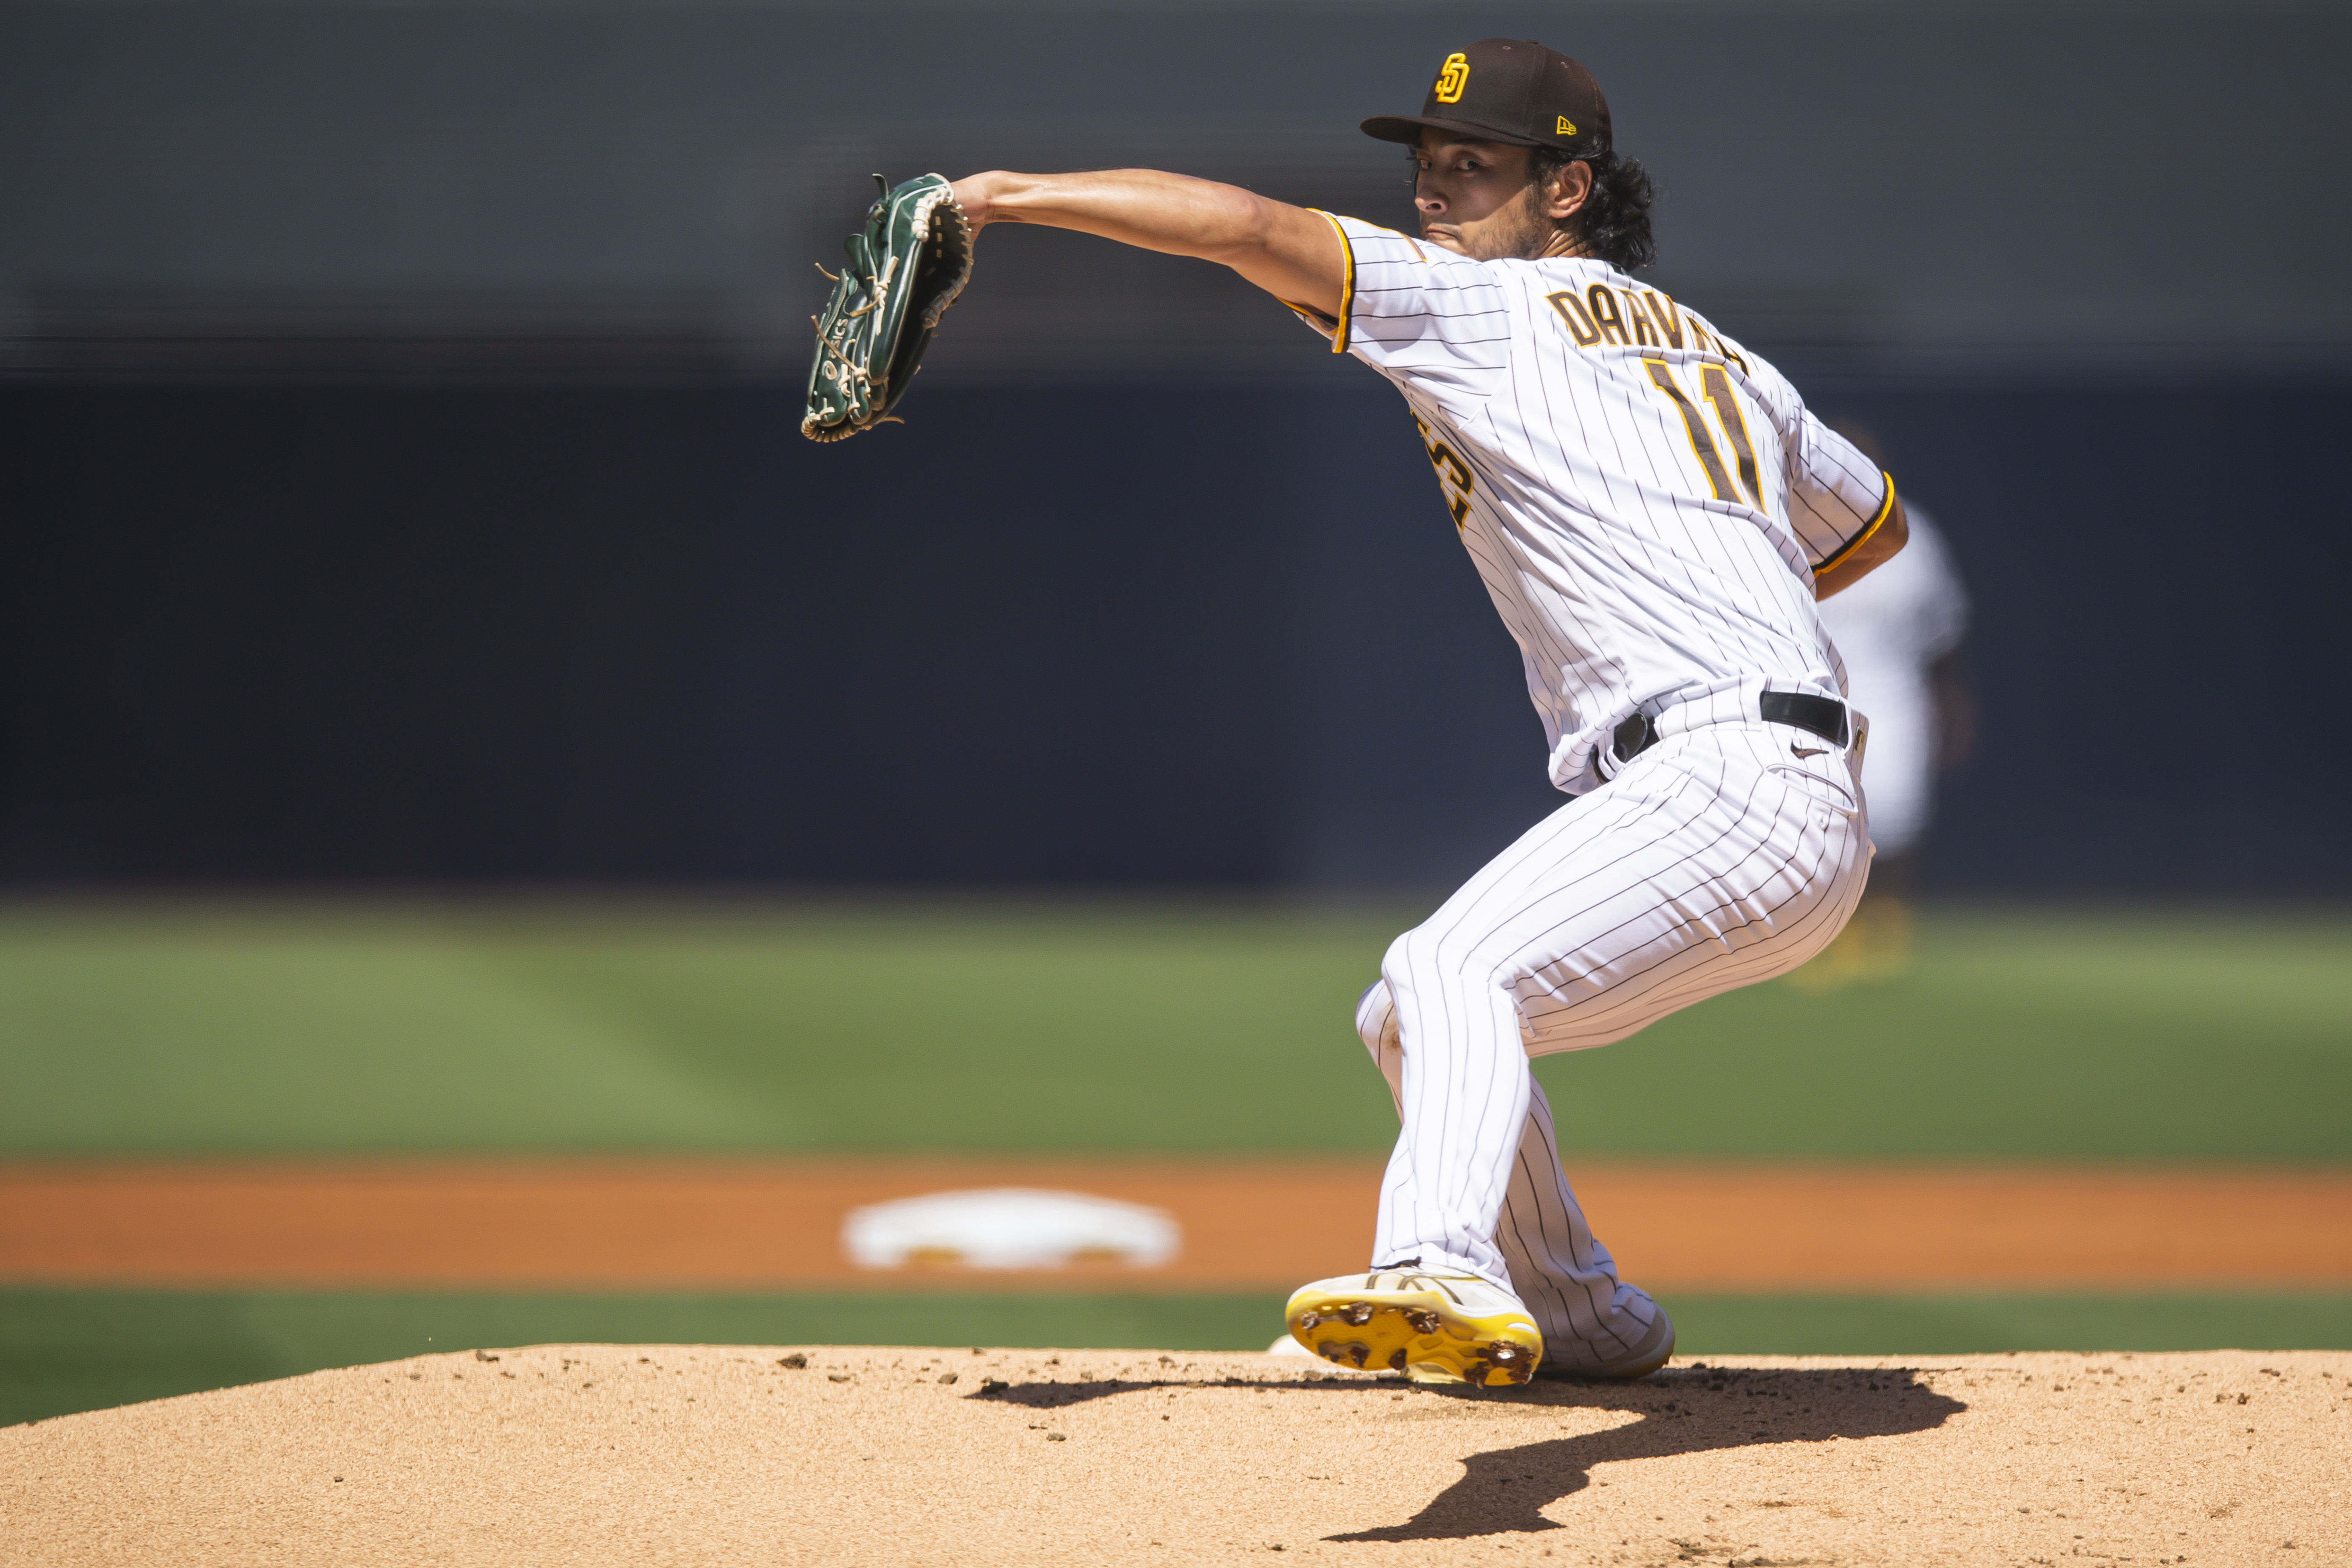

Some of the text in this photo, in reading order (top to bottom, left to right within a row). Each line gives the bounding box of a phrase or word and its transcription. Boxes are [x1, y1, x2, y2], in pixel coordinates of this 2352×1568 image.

[1435, 53, 1470, 104] SD
[1545, 283, 1751, 378] DARVIH
[1642, 358, 1769, 518] 11
